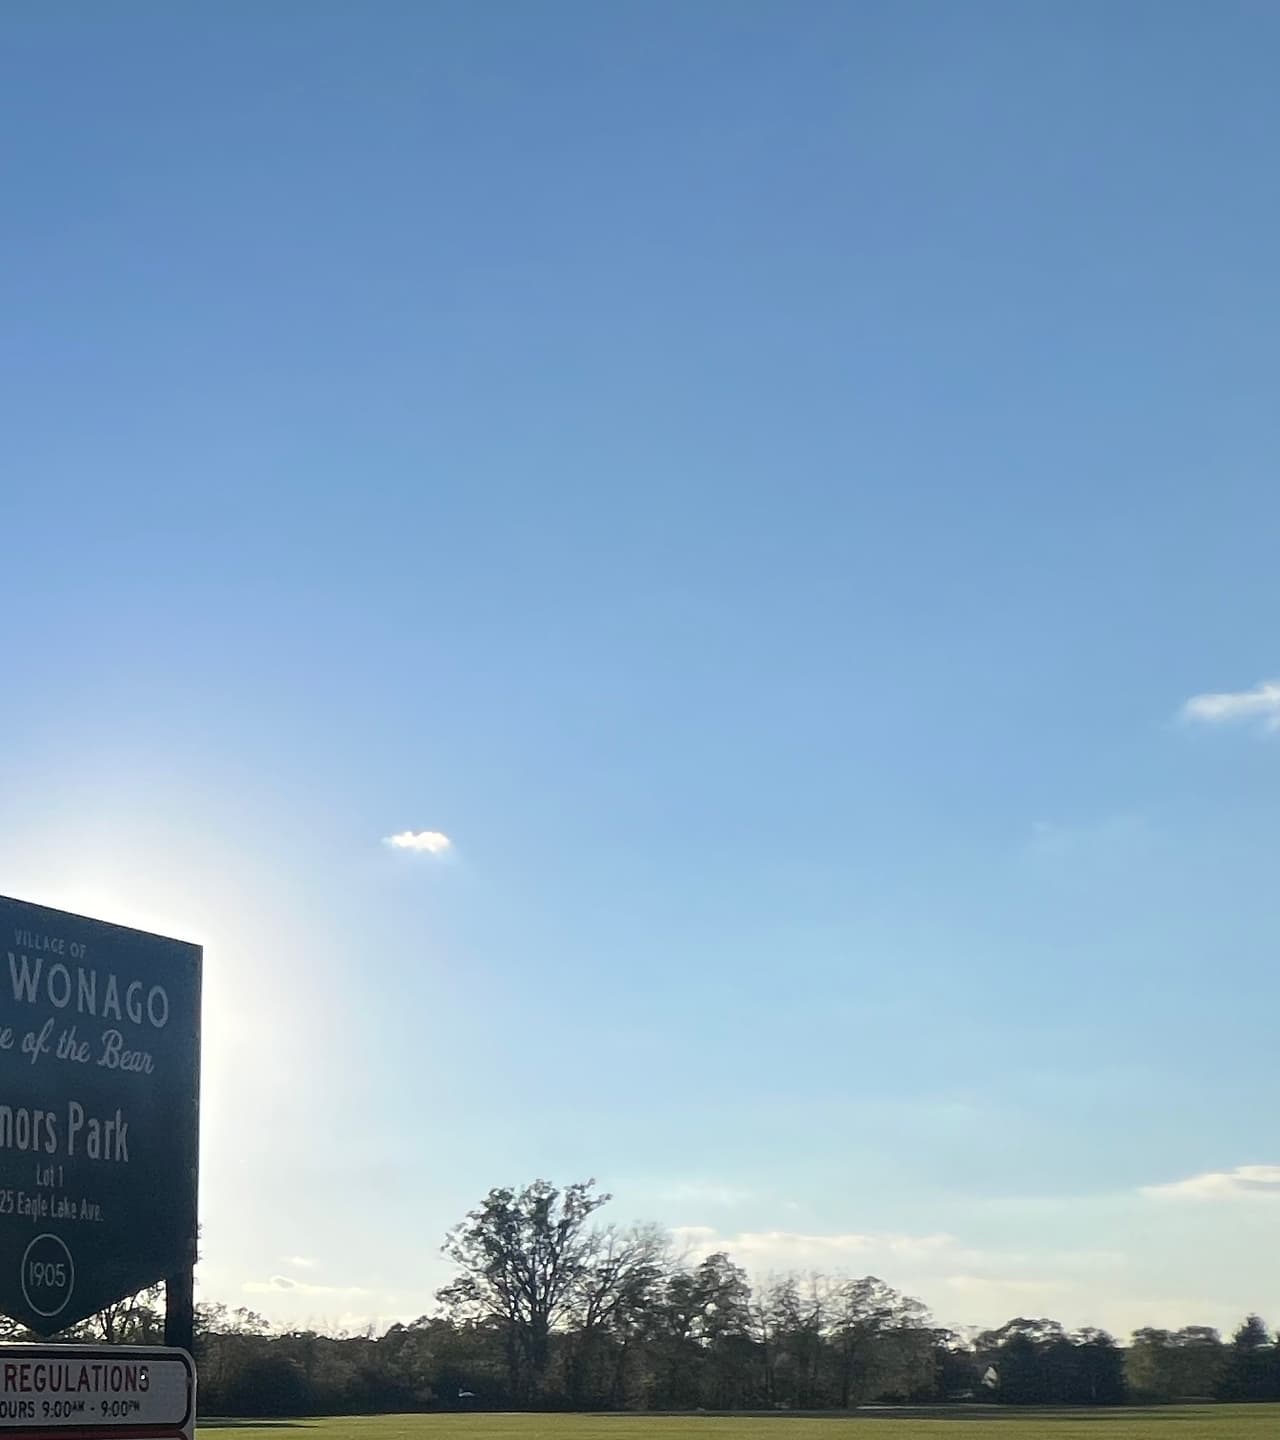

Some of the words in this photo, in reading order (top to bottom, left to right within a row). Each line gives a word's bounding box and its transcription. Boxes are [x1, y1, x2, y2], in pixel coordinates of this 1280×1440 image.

[14, 929, 65, 954] VILLAGE
[70, 942, 87, 959] OF
[21, 1017, 55, 1064] of
[56, 1027, 91, 1064] the
[97, 1029, 155, 1075] Bear
[68, 1100, 129, 1163] Park
[36, 1165, 54, 1188] Lot
[57, 1166, 64, 1187] 1
[17, 1192, 47, 1224] Eagle
[50, 1196, 77, 1220] Lake
[29, 1262, 67, 1288] 1905
[4, 1363, 150, 1393] REGULATIONS
